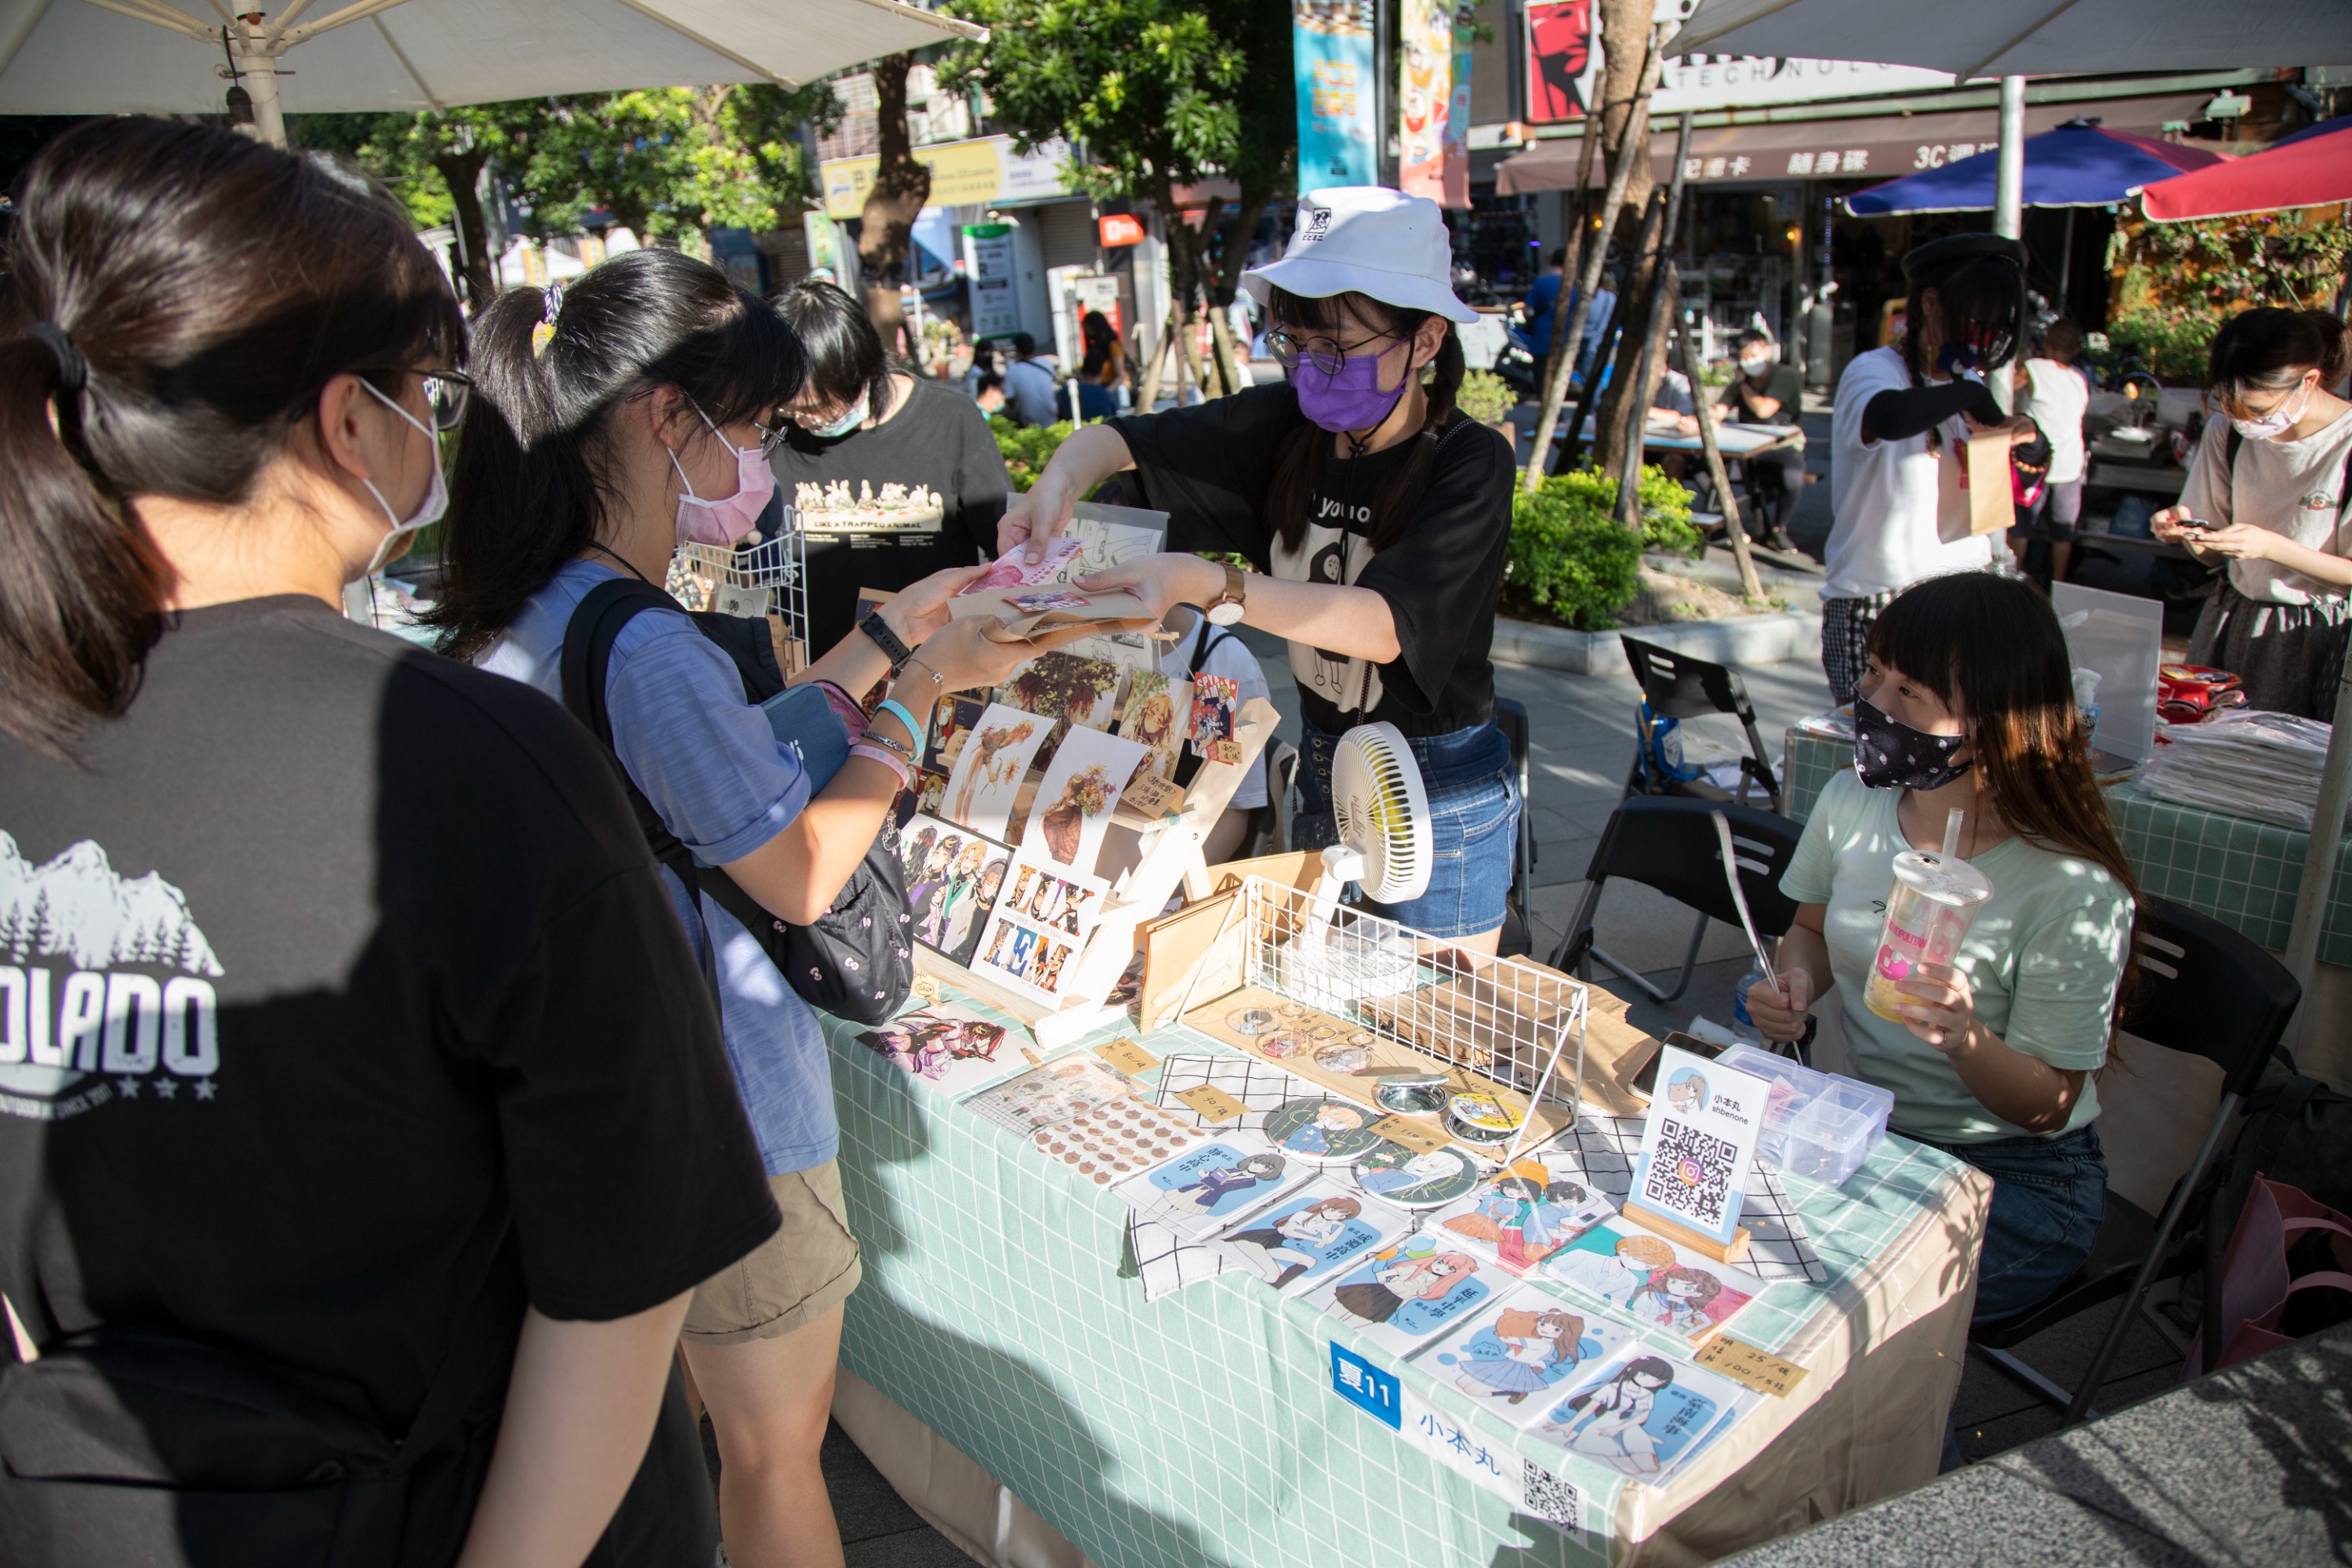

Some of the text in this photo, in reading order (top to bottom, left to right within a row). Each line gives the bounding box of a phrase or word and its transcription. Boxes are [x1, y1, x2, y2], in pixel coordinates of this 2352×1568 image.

[1005, 863, 1095, 937] LUX
[1711, 1105, 1749, 1125] shbenone
[1714, 1094, 1741, 1112] 小本丸
[1429, 1287, 1479, 1318] 延平中學
[1338, 1357, 1389, 1407] 夏11
[1420, 1414, 1501, 1476] 小本丸
